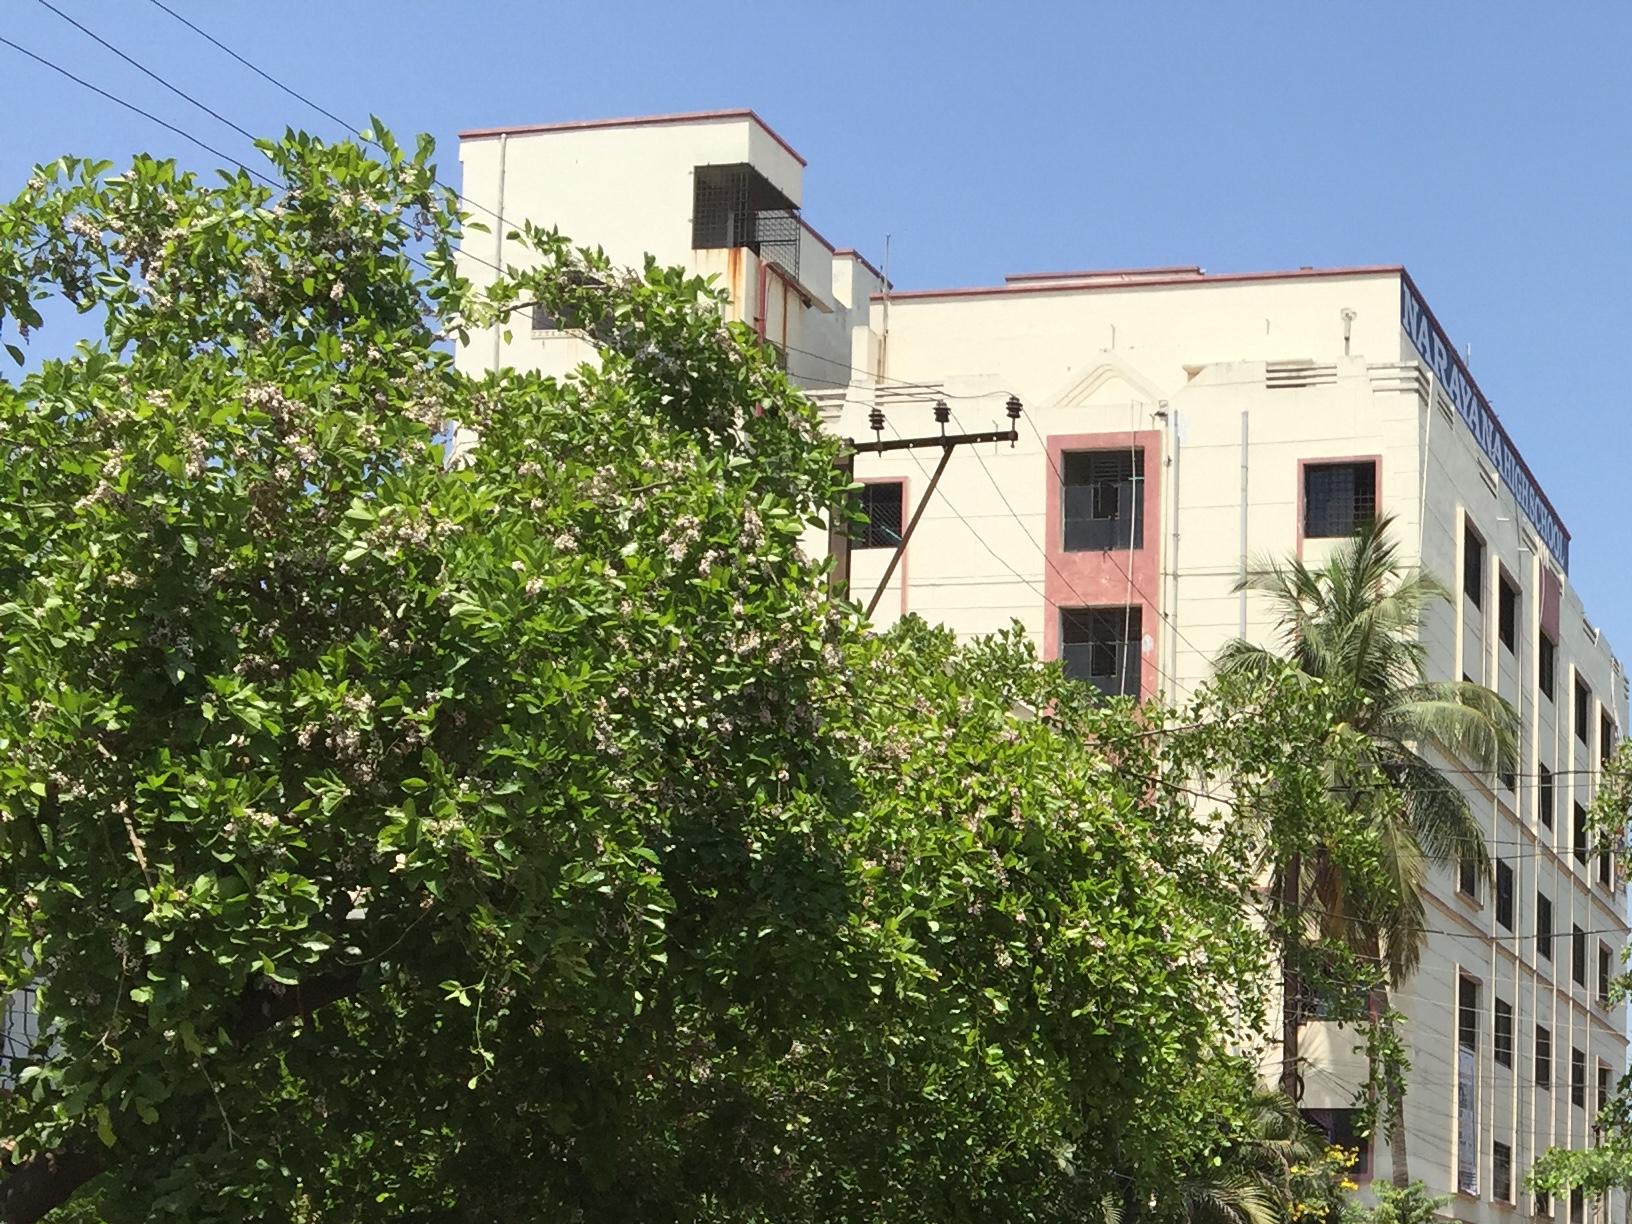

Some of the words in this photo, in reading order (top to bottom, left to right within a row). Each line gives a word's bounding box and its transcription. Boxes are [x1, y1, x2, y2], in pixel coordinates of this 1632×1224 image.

[1402, 286, 1502, 469] NARAYANA
[1503, 443, 1530, 513] HIGH
[1530, 486, 1566, 566] SCHOOL
